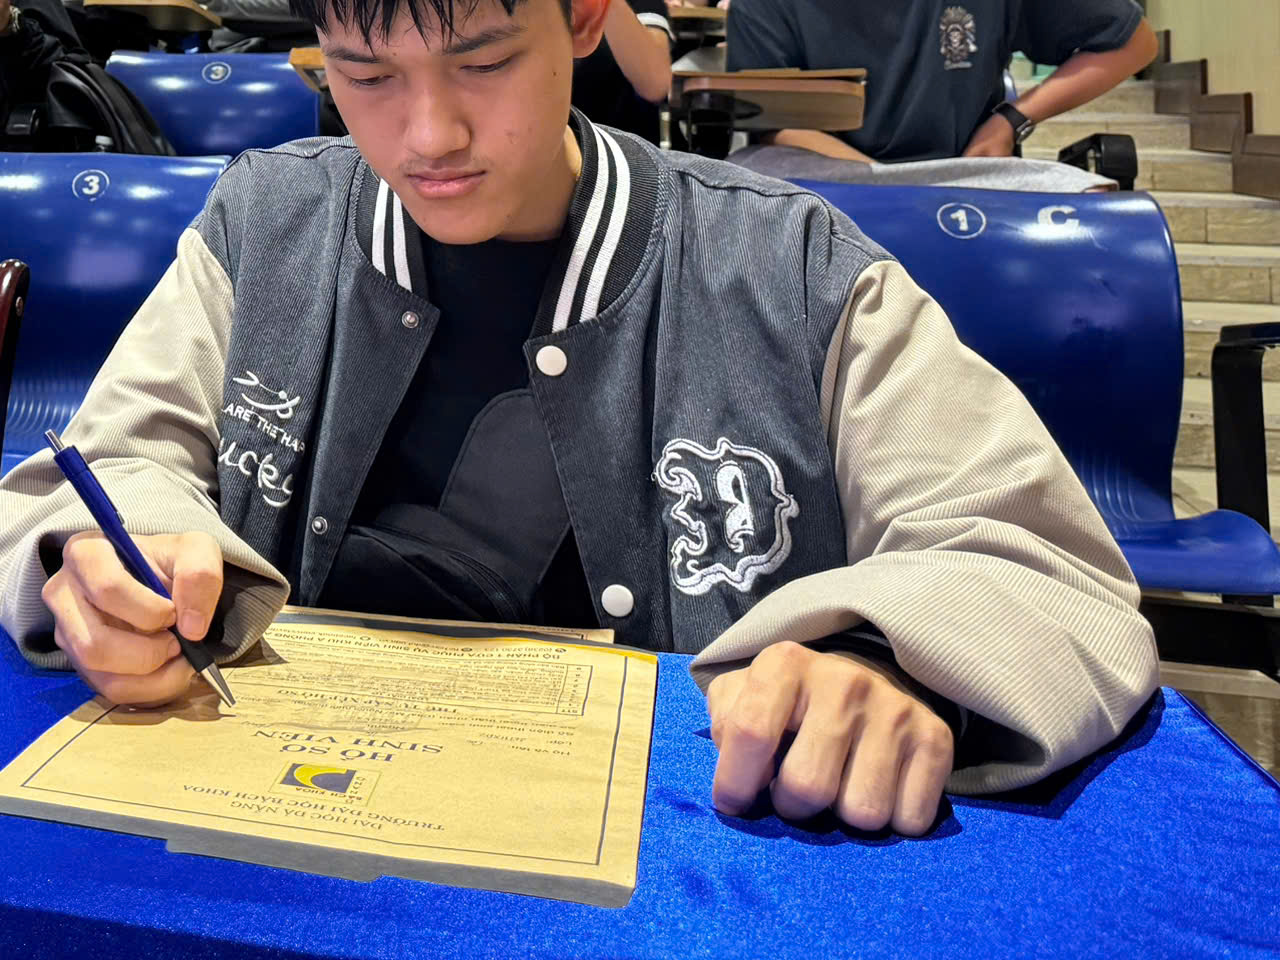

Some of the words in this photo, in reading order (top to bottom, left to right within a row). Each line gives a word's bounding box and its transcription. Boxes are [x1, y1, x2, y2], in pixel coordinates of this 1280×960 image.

[223, 402, 253, 422] ARE
[256, 416, 279, 439] THE
[251, 730, 339, 744] VIÊN
[278, 744, 330, 755] SƠ
[352, 738, 444, 754] SINH
[183, 784, 230, 796] KHOA
